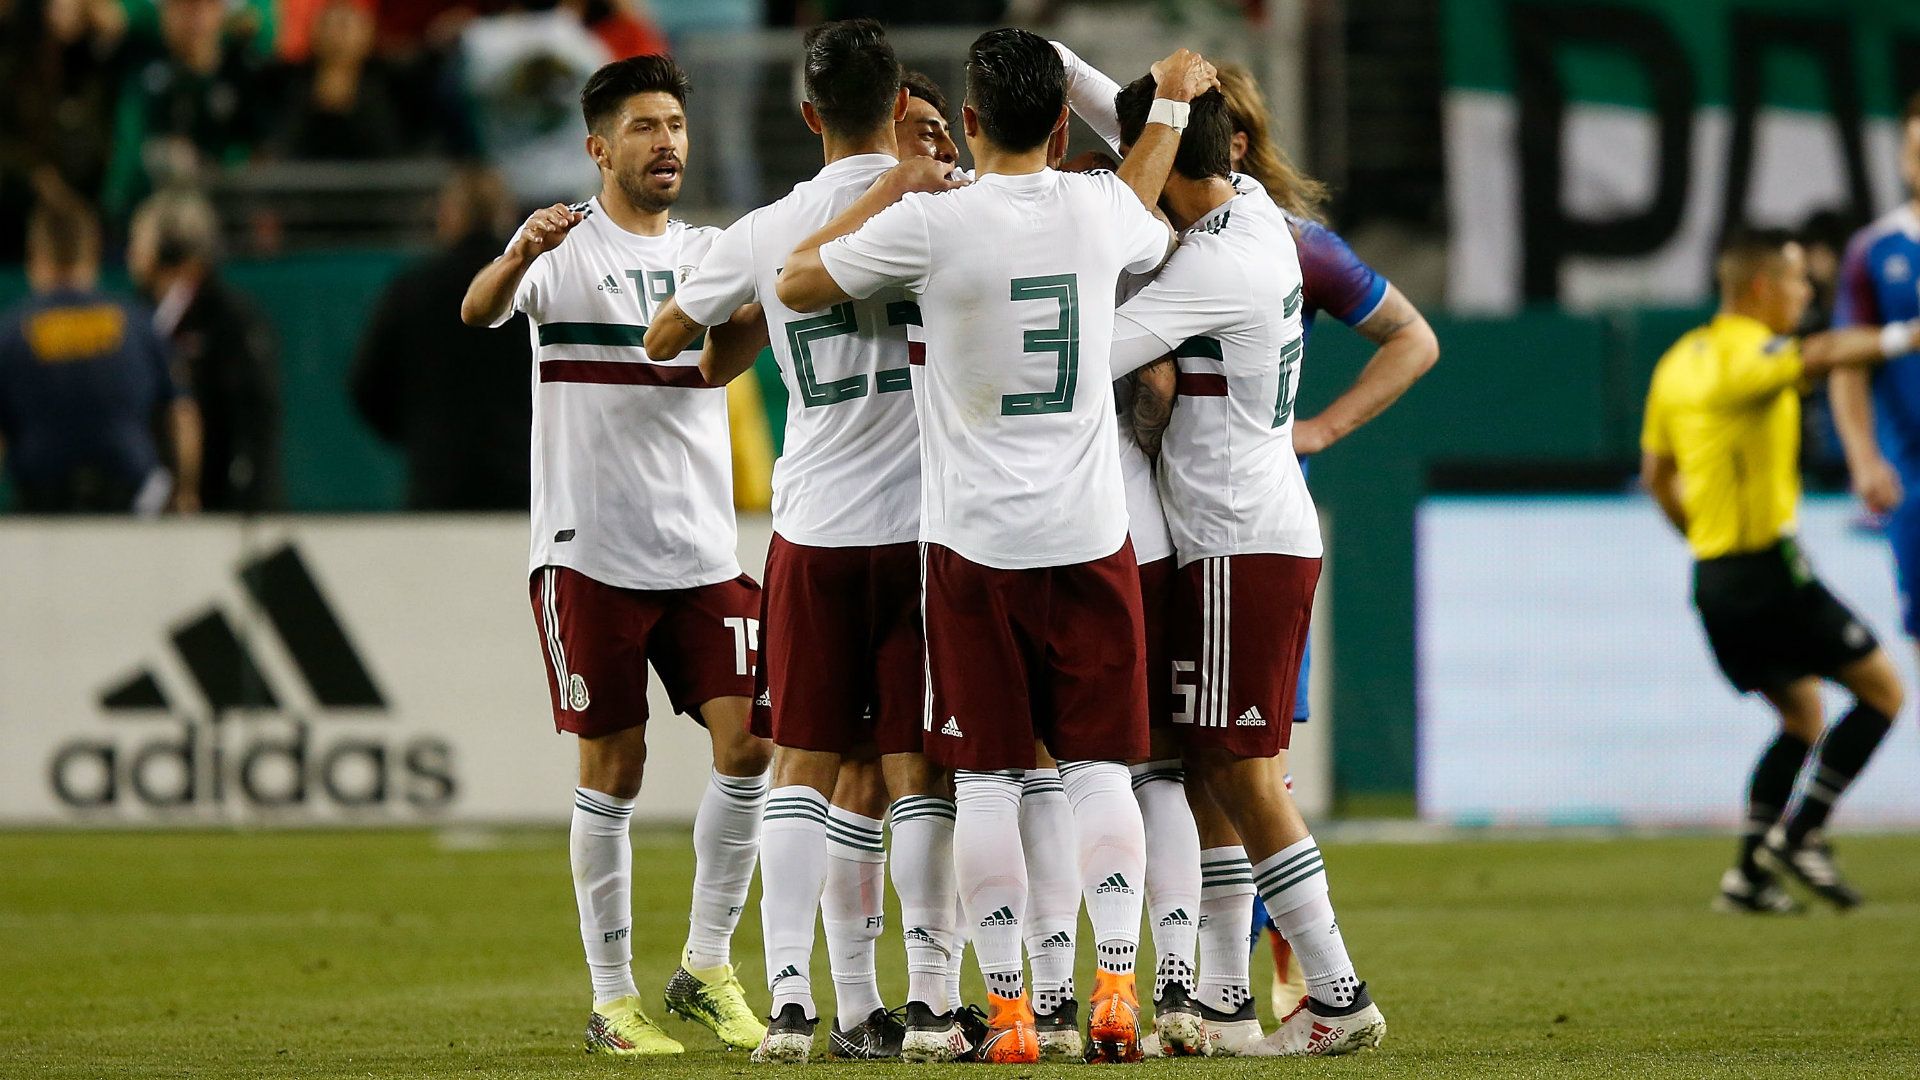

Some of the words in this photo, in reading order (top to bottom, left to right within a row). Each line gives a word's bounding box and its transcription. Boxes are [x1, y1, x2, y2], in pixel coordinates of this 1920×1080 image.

[1511, 3, 1920, 306] PA
[777, 267, 913, 408] 2
[1001, 273, 1079, 416] 3
[1235, 718, 1266, 727] adidas
[941, 727, 963, 738] adidas
[51, 713, 457, 807] adidas
[1096, 886, 1134, 894] adidas
[980, 919, 1018, 927] adidas
[1160, 919, 1192, 927] adidas
